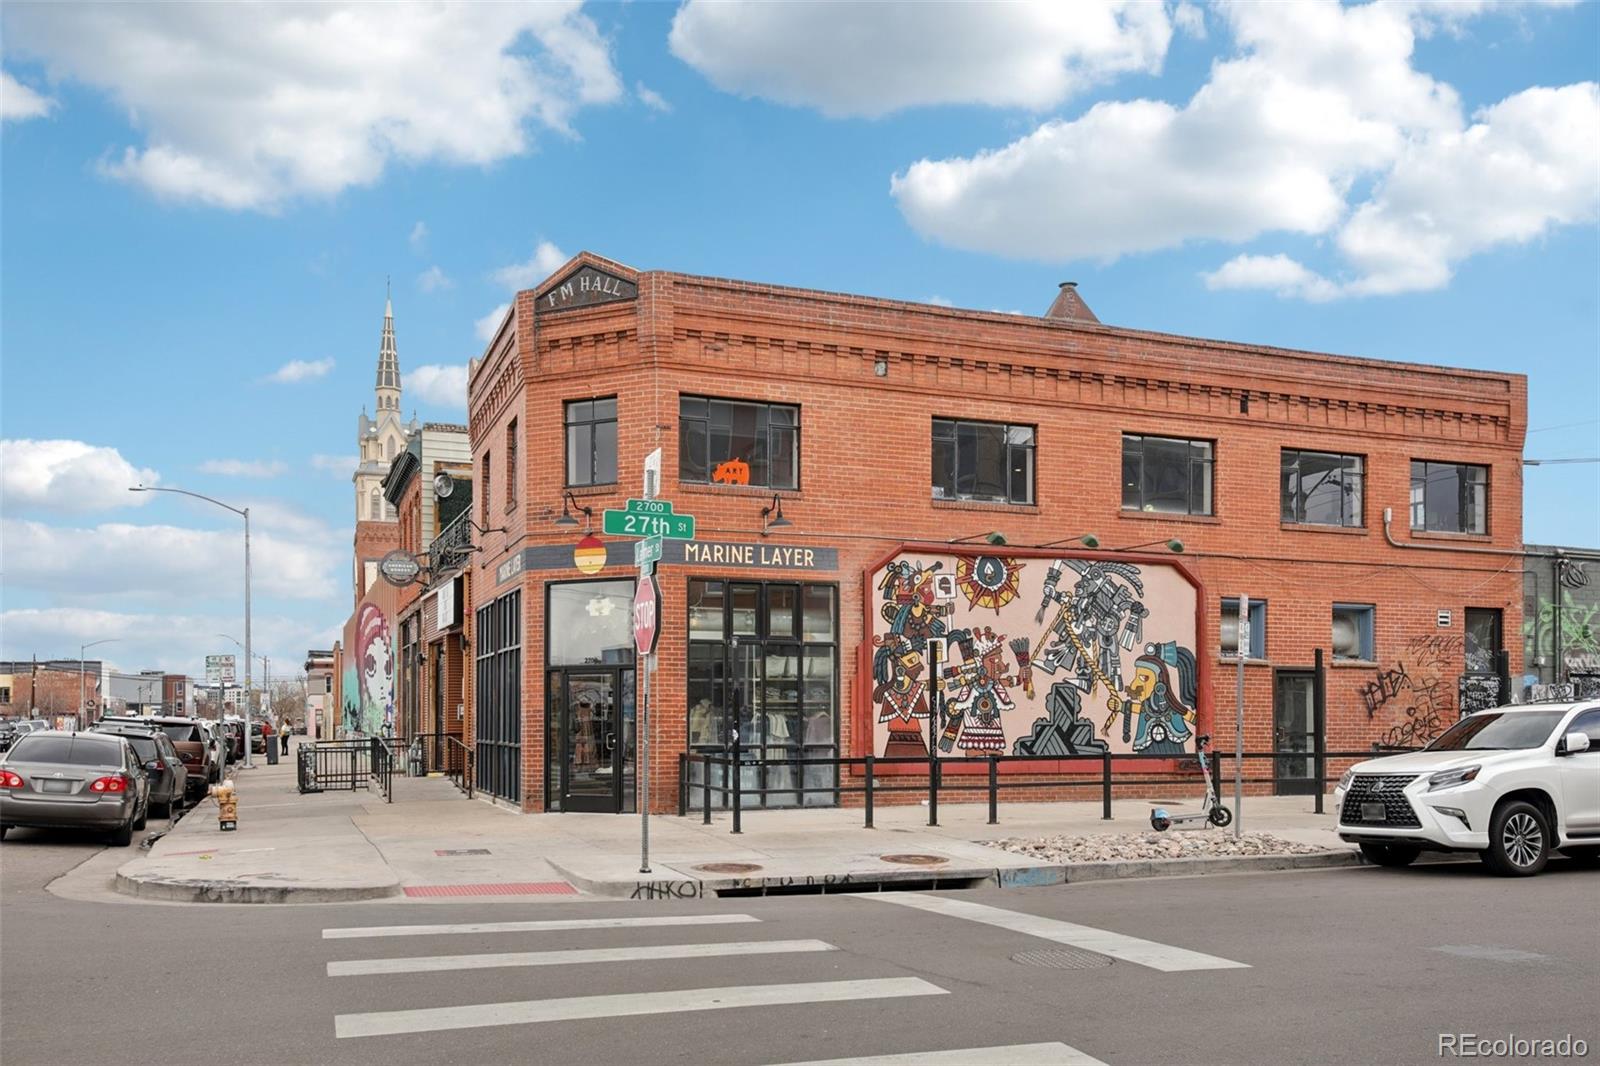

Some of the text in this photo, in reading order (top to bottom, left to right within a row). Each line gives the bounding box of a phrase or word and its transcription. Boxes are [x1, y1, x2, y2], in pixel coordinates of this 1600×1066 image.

[580, 276, 621, 296] HALL
[636, 502, 664, 512] 2700
[624, 515, 687, 534] 27th St
[685, 544, 815, 567] MARINE LAYER
[635, 600, 653, 630] STOP
